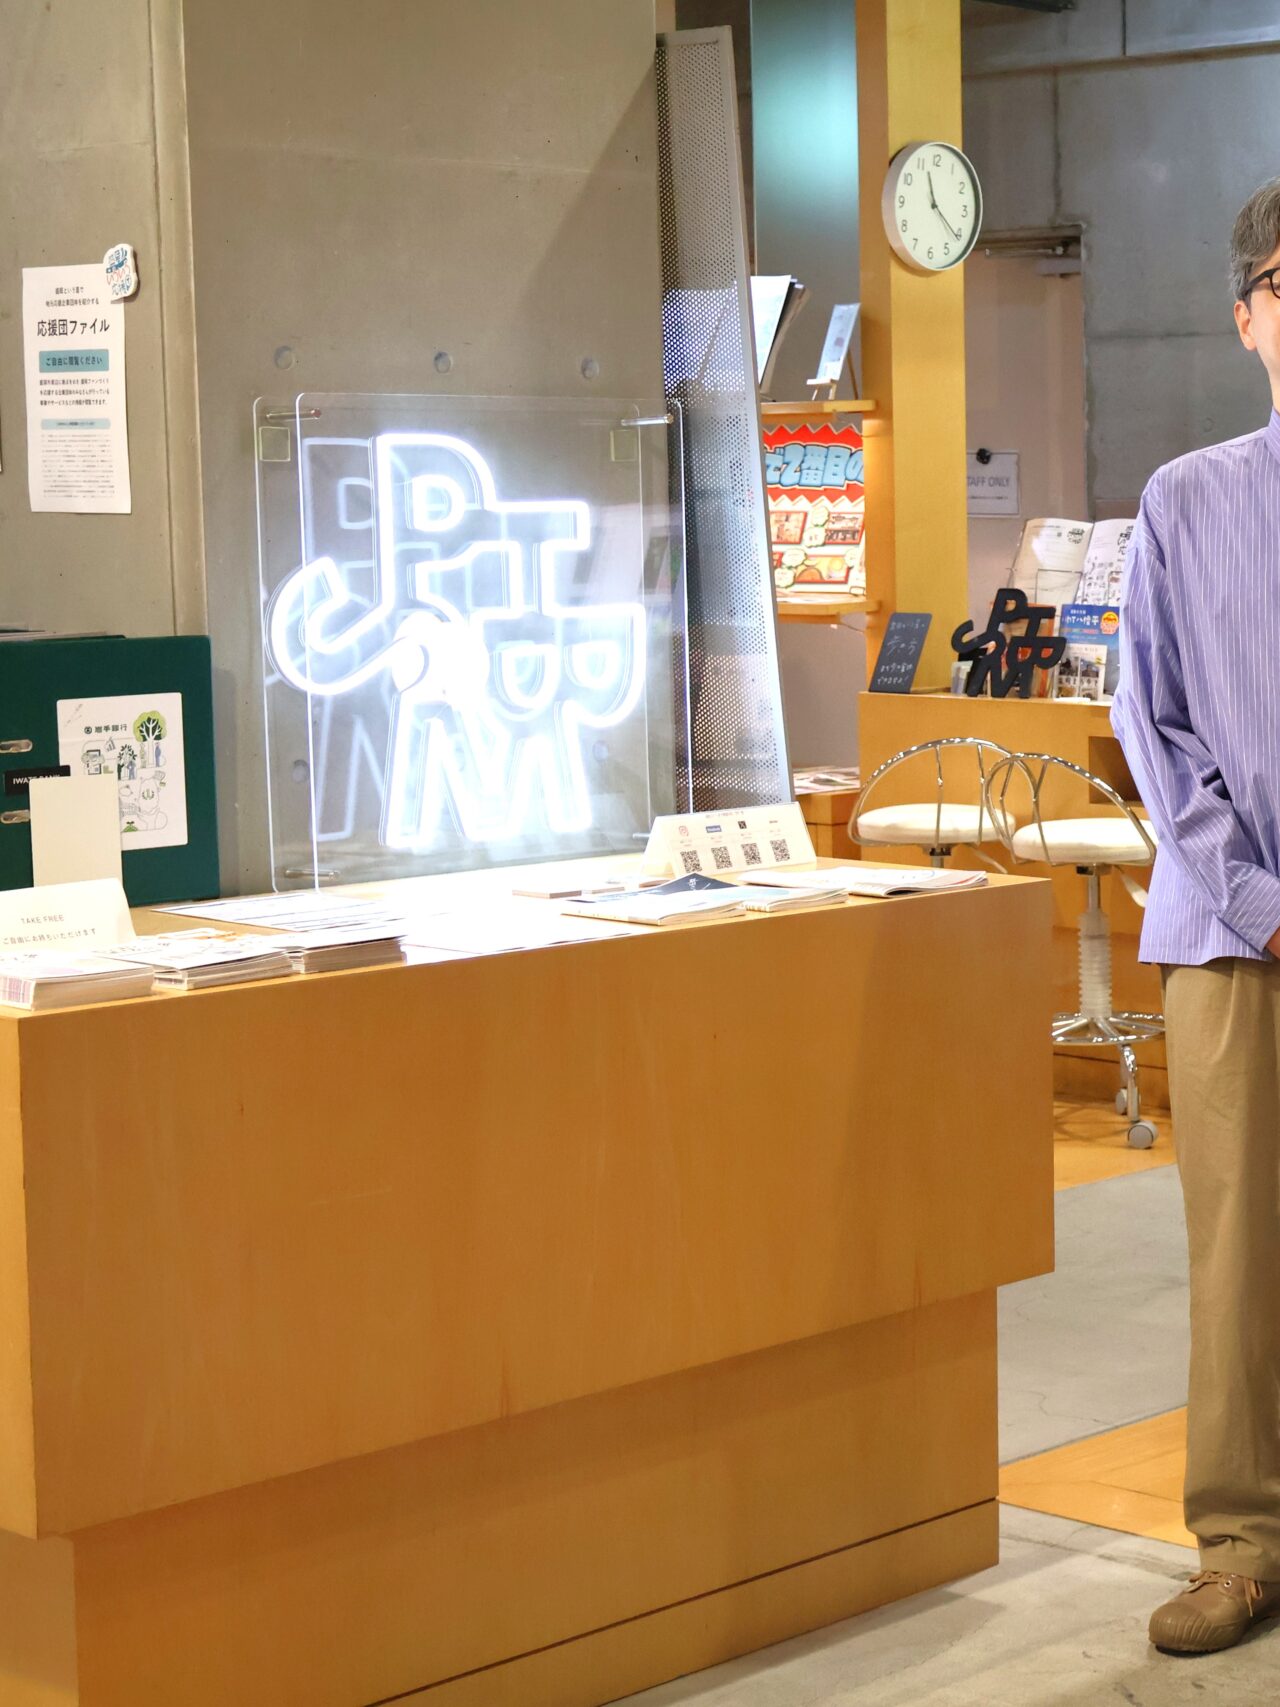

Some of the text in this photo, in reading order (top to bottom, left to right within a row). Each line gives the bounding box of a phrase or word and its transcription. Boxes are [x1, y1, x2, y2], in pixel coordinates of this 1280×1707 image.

[917, 158, 925, 170] 11
[933, 154, 942, 167] 12
[903, 173, 913, 186] 10
[959, 182, 965, 194] 2
[899, 195, 905, 208] 9
[961, 205, 968, 218] 3
[901, 220, 908, 232] 8
[912, 238, 918, 251] 7
[943, 243, 950, 255] 5
[927, 247, 934, 260] 6
[37, 317, 110, 338] 応援団ファイル
[46, 356, 103, 367] ご自由に閲覧ください
[967, 476, 1010, 488] TAFF ONLY
[94, 724, 127, 733] 岩手銀行
[43, 914, 65, 922] FREE
